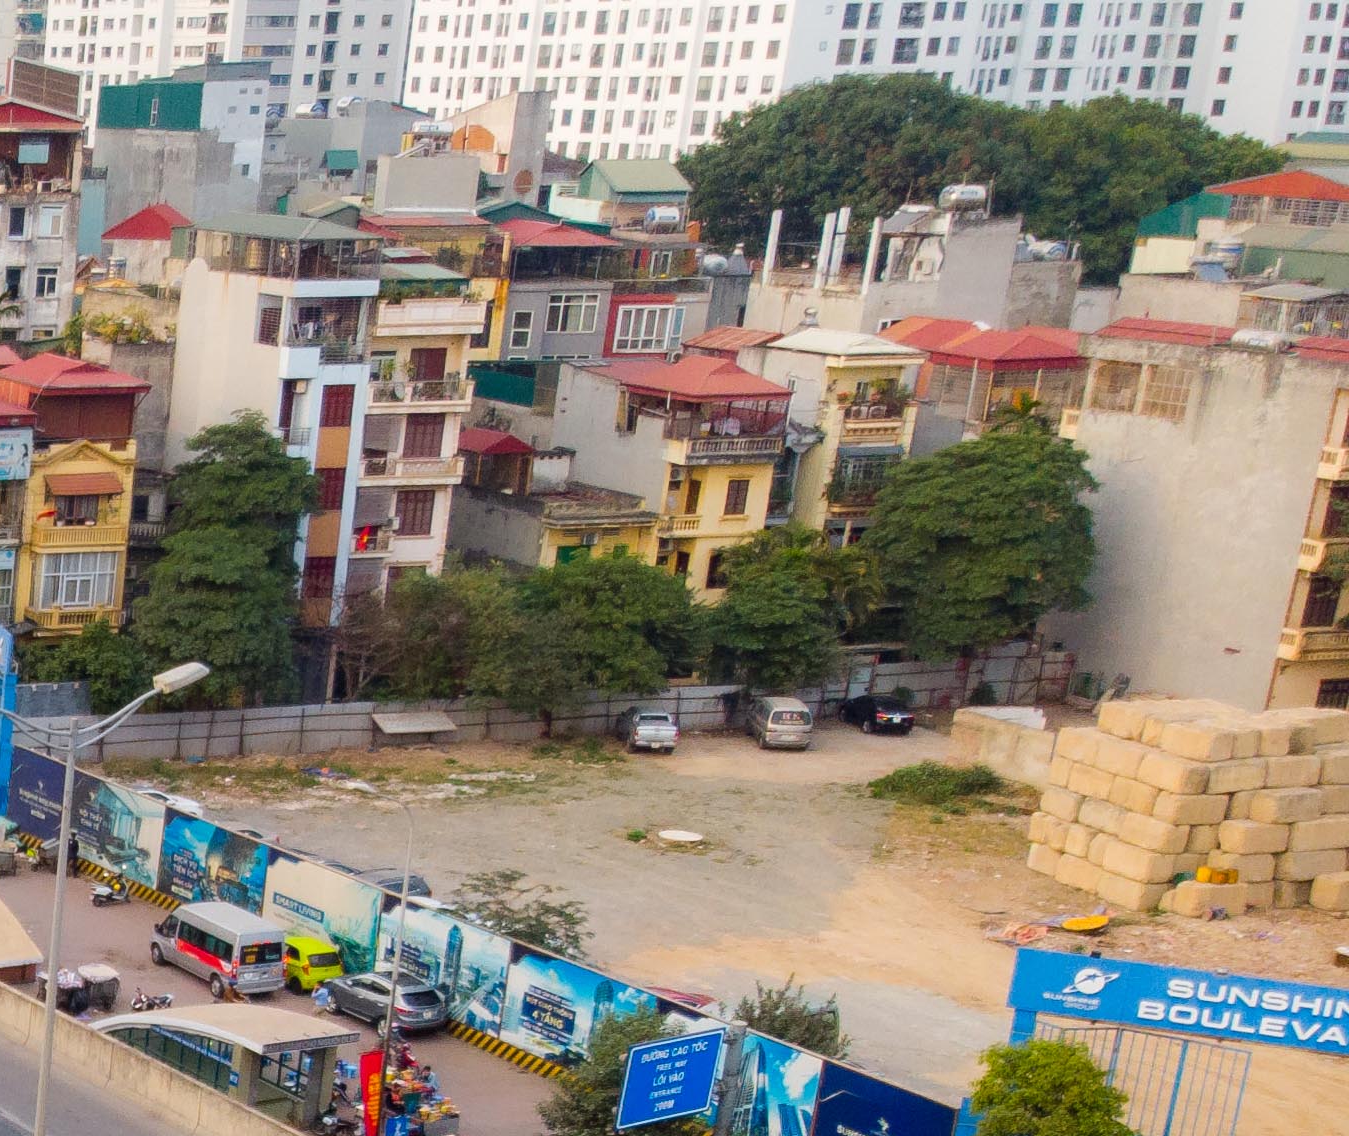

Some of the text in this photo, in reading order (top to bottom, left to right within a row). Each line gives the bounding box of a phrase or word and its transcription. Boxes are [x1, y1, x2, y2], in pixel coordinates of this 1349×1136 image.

[1042, 991, 1100, 1006] SUNSHINE
[1137, 1000, 1348, 1047] BOULEVA
[671, 1045, 689, 1057] CAO
